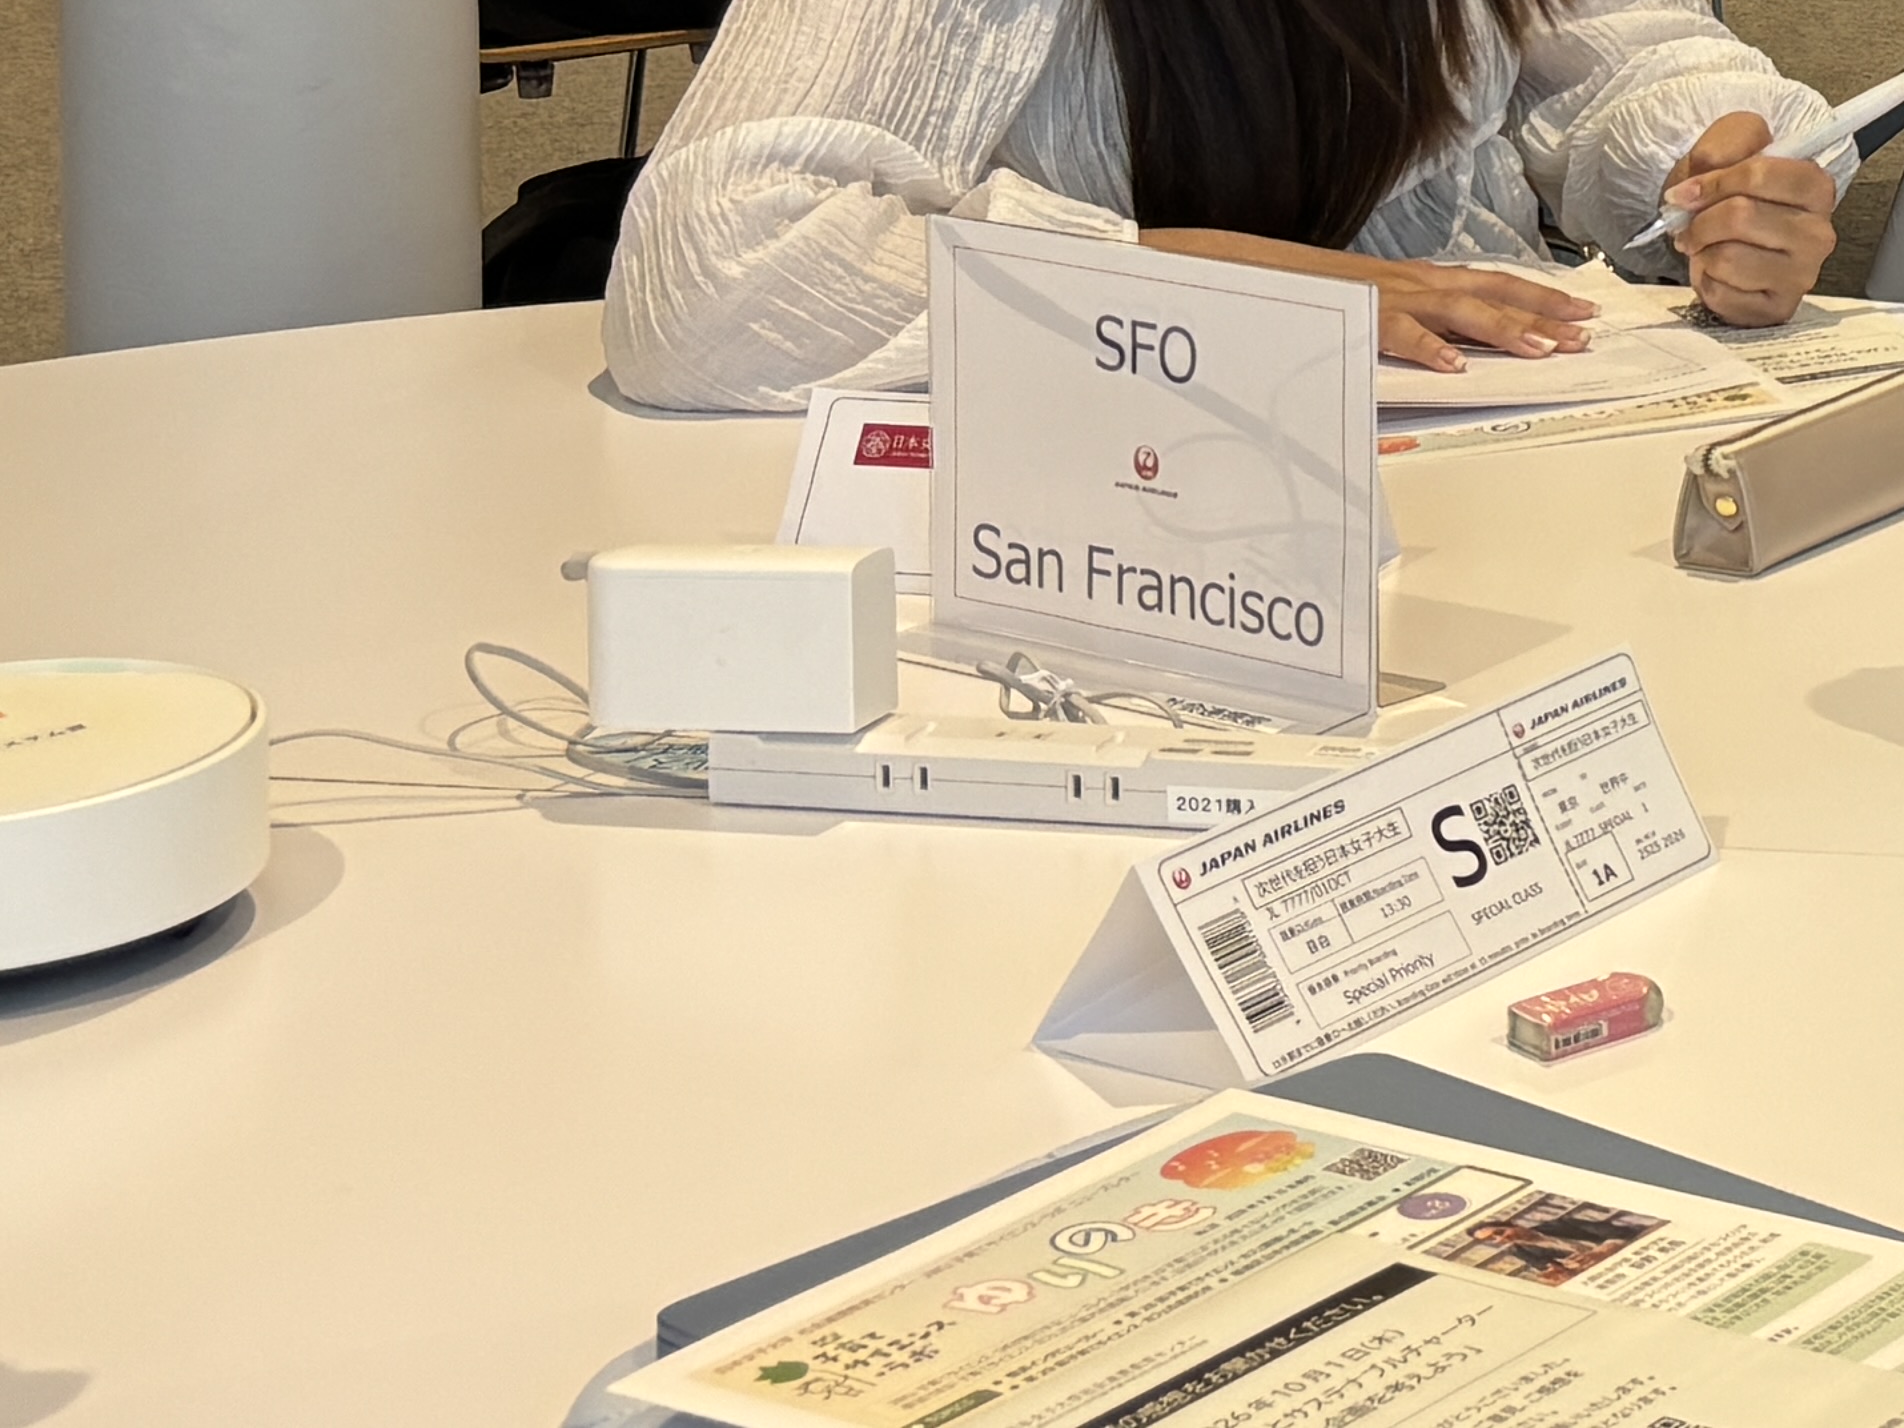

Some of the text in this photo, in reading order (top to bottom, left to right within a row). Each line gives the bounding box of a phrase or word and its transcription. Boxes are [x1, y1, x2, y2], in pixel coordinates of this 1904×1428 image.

[1095, 314, 1197, 384] SFO
[972, 523, 1324, 647] San Francisco
[1199, 799, 1346, 876] JAPAN AIRLINES
[1431, 804, 1488, 888] S
[1471, 882, 1543, 925] SPECIAL CLASS
[1590, 859, 1618, 887] 1A
[1340, 948, 1438, 1009] Special Priority
